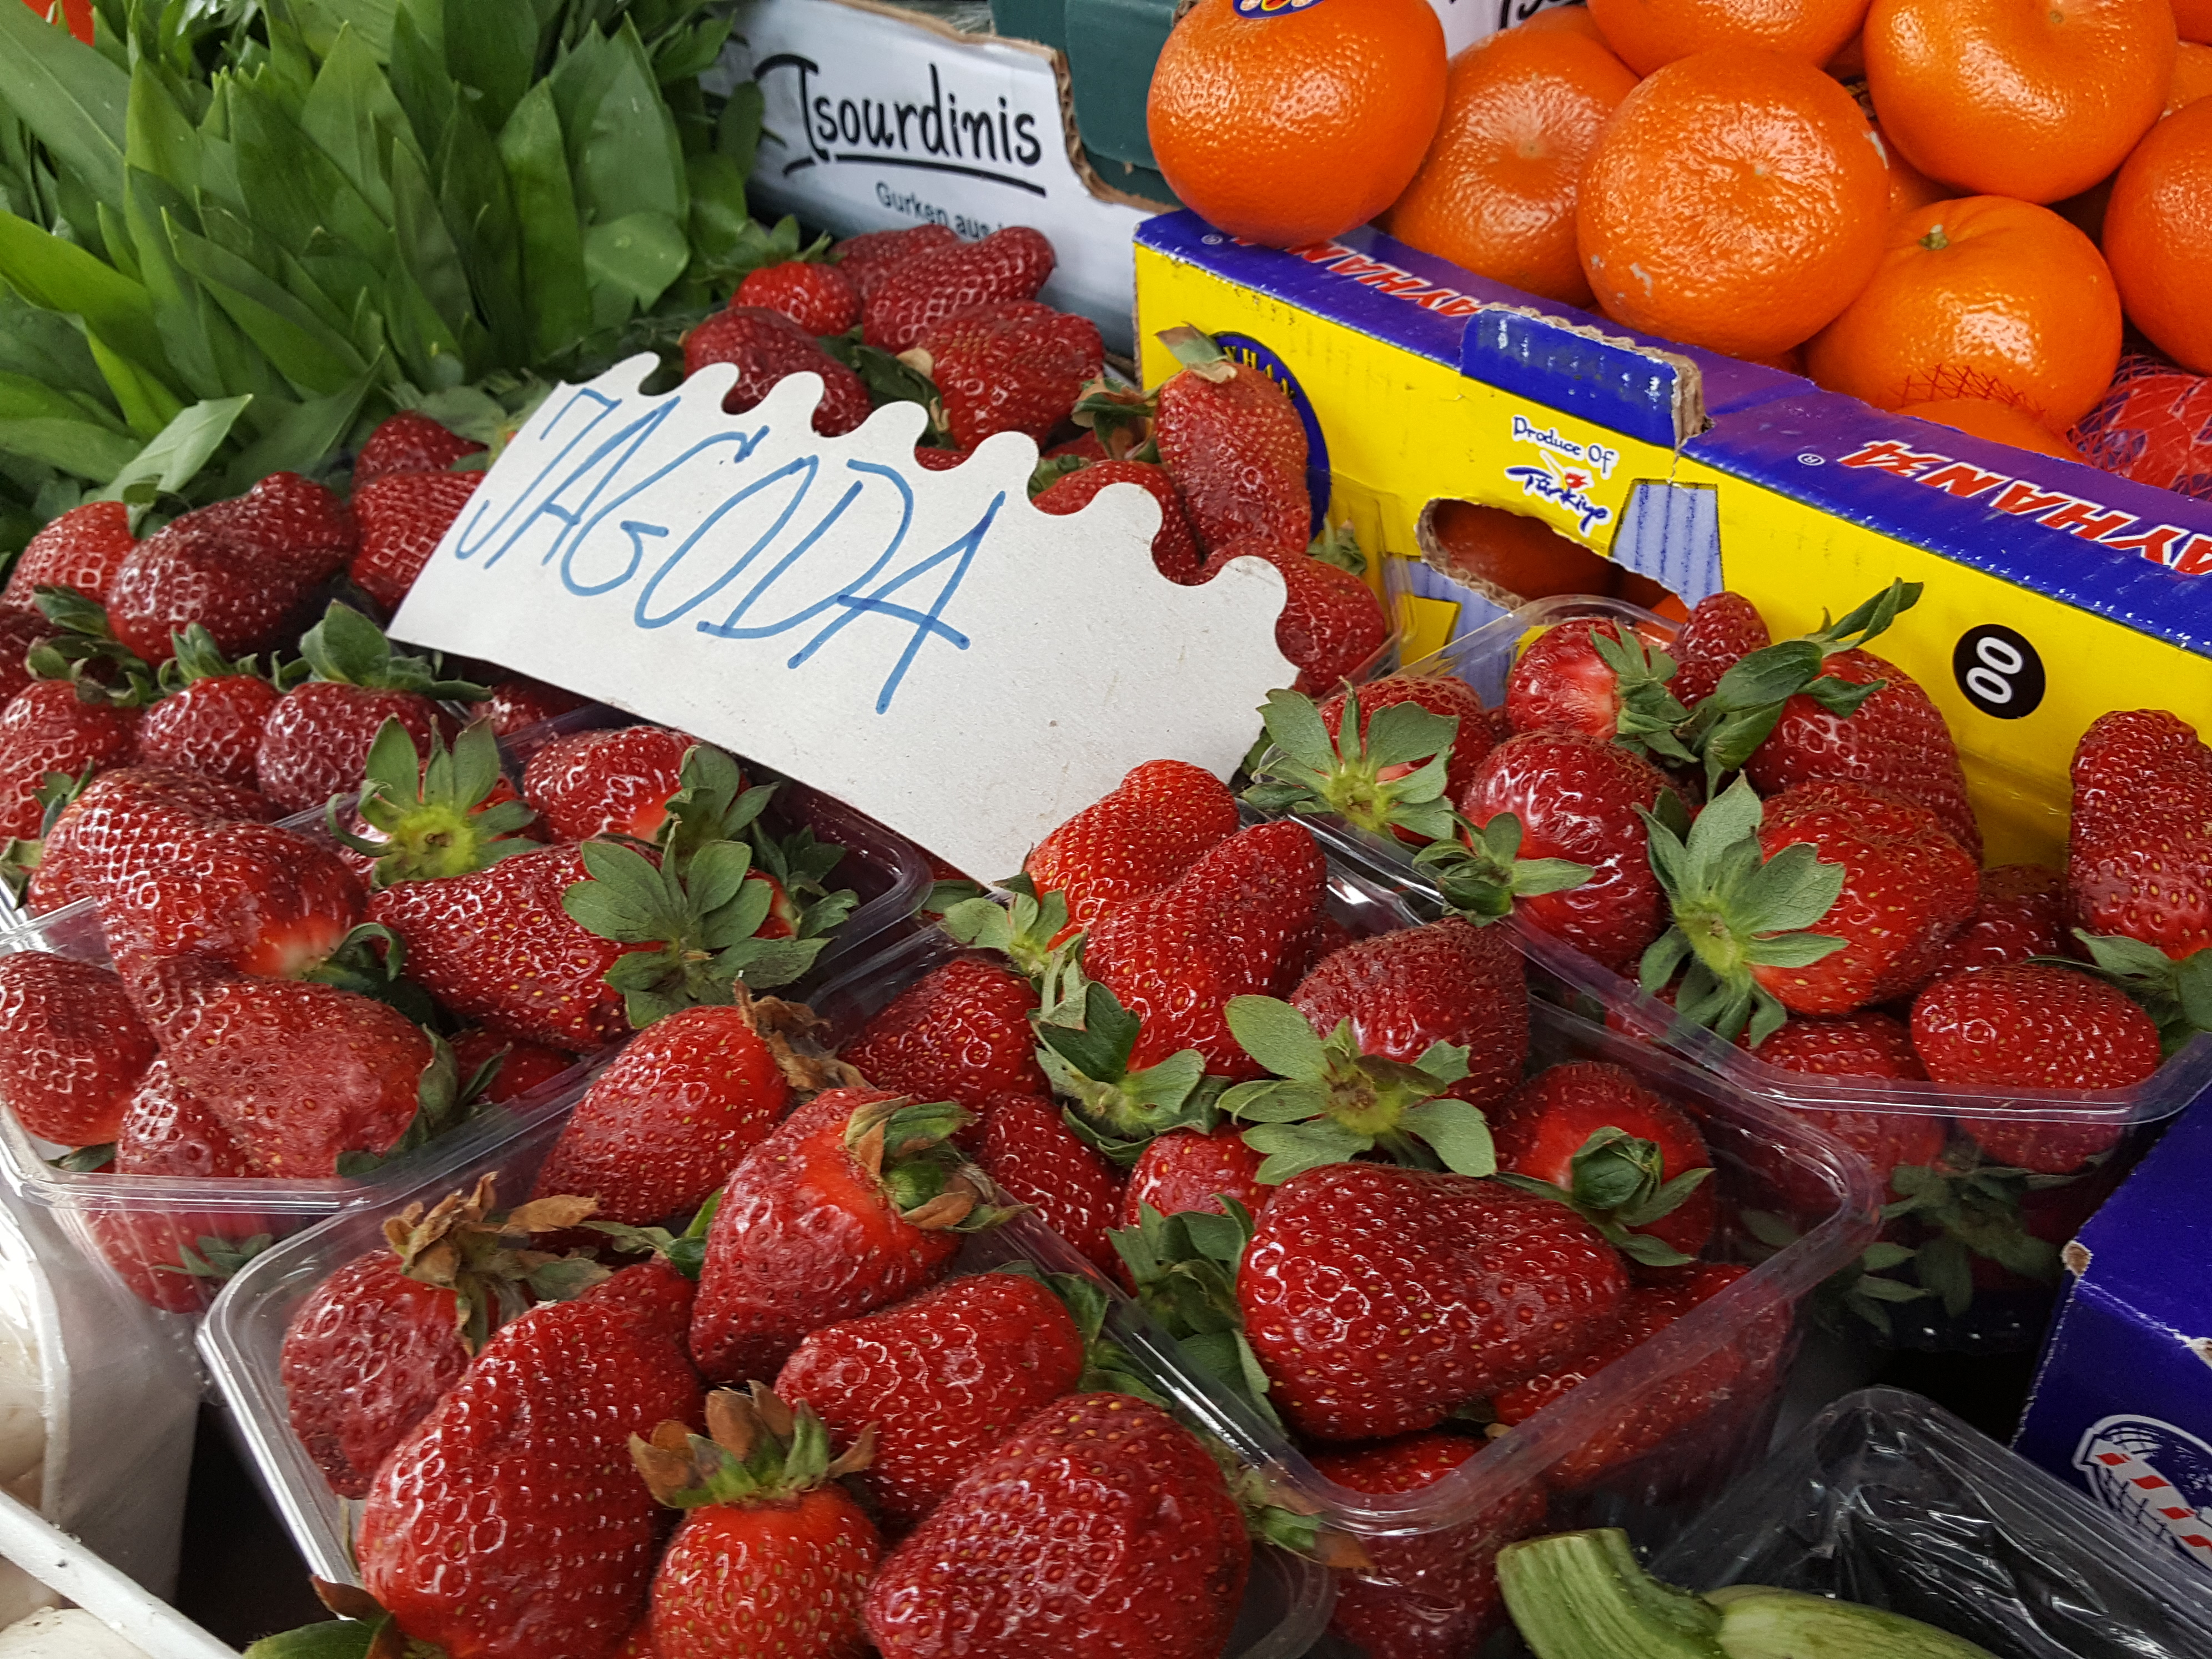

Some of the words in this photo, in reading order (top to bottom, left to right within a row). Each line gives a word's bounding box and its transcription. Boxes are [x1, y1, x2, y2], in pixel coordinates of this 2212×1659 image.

[752, 54, 1042, 165] Tsourdinis
[875, 180, 949, 226] Gurken
[1233, 237, 1484, 316] AYHAN
[1511, 415, 1582, 456] Produce
[1587, 444, 1615, 474] Of
[454, 388, 1006, 715] JAGODA
